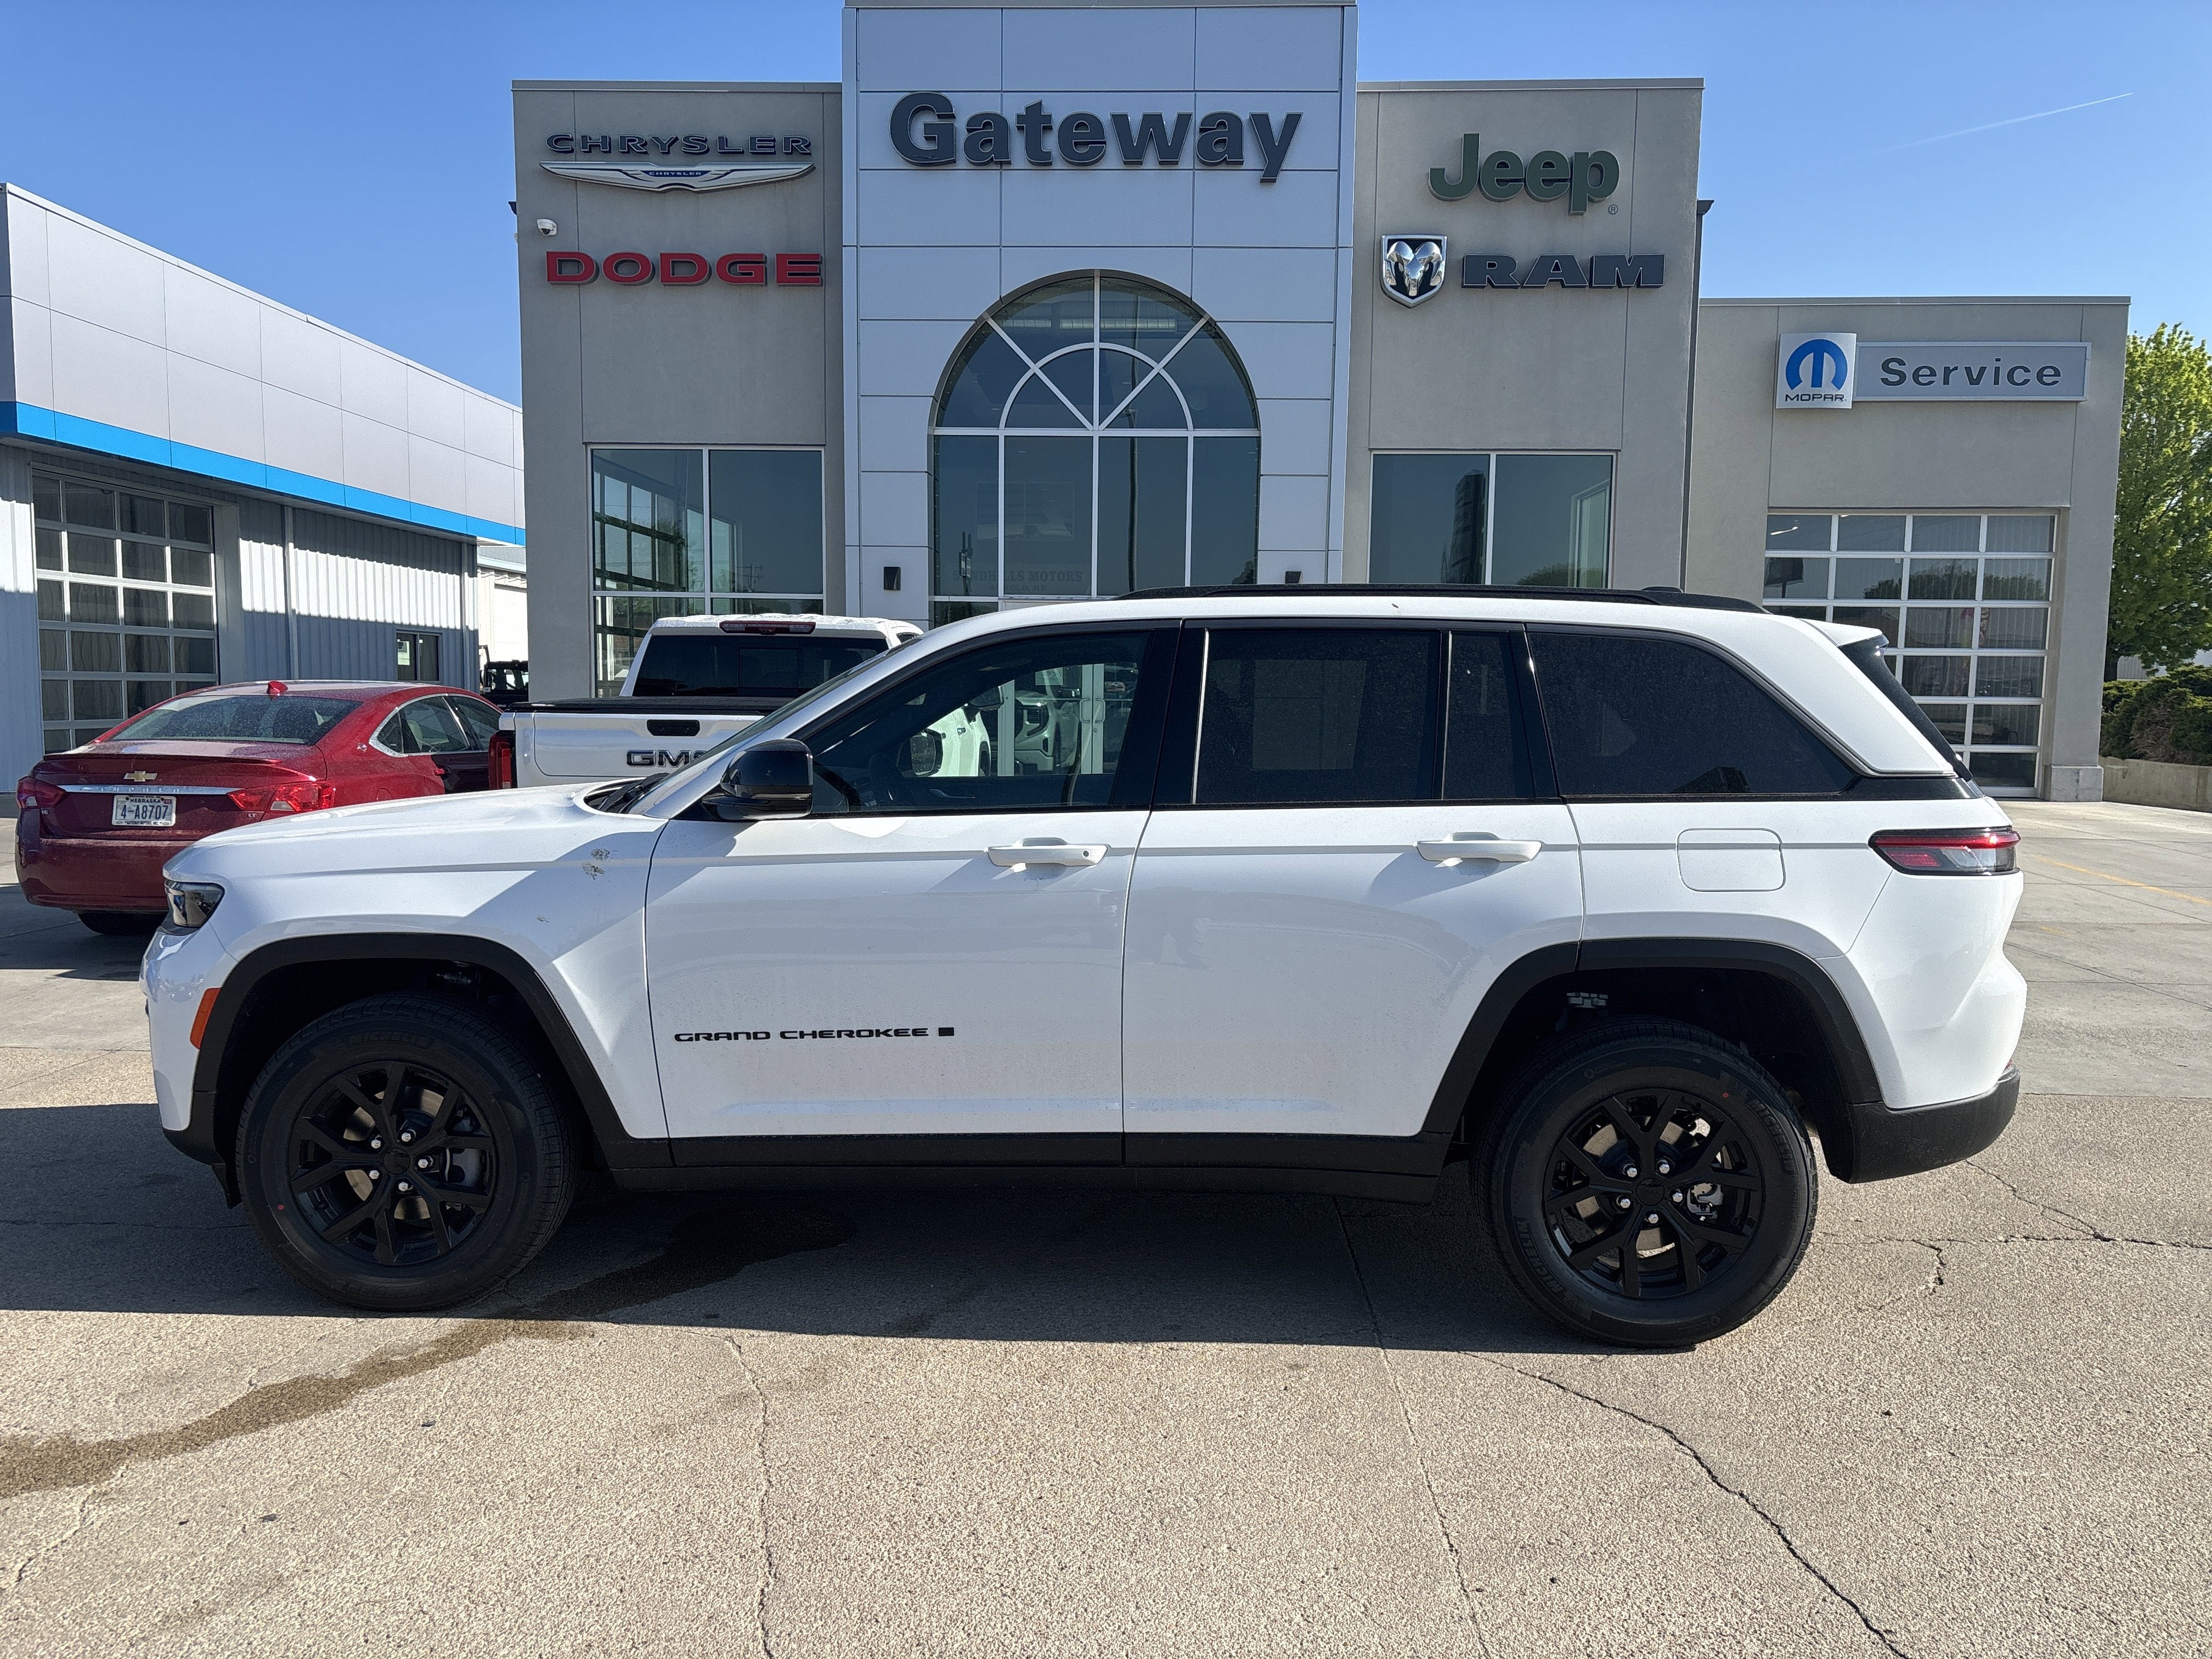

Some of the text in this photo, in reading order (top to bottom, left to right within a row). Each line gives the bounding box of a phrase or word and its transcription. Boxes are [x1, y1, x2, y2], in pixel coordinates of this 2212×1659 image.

[545, 133, 811, 154] CHRYSLER
[889, 92, 1304, 183] Gateway
[1428, 132, 1620, 215] Jeep
[545, 251, 822, 286] DODGE
[1462, 253, 1666, 289] RAM
[1880, 358, 2062, 386] Service
[1785, 393, 1844, 402] MOPAR
[953, 571, 1083, 582] SNDHLS MOTORS
[121, 805, 168, 820] 4-A8707
[674, 1028, 929, 1042] GRAND CHEROKEE
